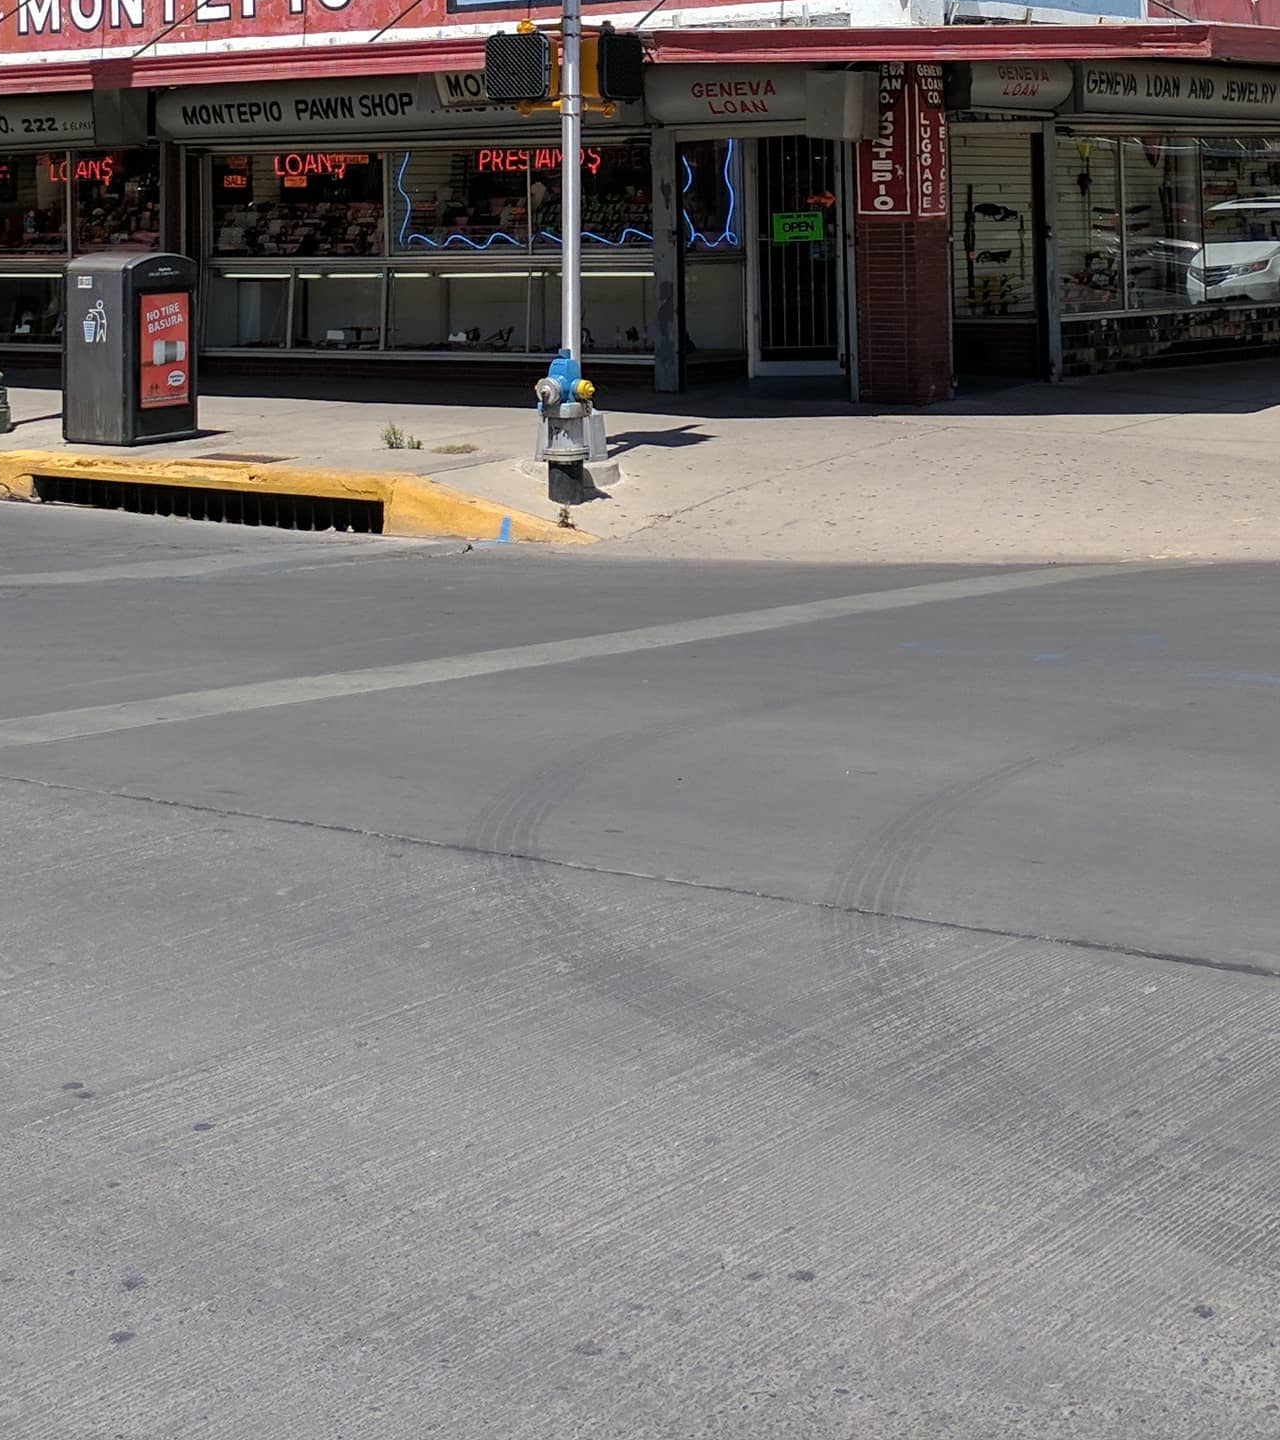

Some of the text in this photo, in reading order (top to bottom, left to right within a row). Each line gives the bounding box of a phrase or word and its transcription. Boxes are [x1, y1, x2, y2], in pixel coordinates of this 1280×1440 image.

[998, 66, 1050, 83] GENEVA
[690, 79, 777, 100] GENEVA
[921, 78, 944, 91] LOAN
[1001, 83, 1040, 97] LOAN
[1086, 70, 1138, 97] GENEVA
[1146, 75, 1181, 98] LOAN
[1188, 78, 1215, 101] AND
[1222, 82, 1278, 104] JEWELRY
[710, 97, 768, 116] LOAN
[927, 92, 942, 105] CO.
[181, 92, 414, 126] MONTEPIO PAWN SHOP
[21, 116, 59, 133] 222
[920, 112, 933, 209] LUGGAGE
[782, 220, 816, 233] OPEN
[146, 302, 182, 323] NO TIRE
[147, 313, 185, 334] BASURA
